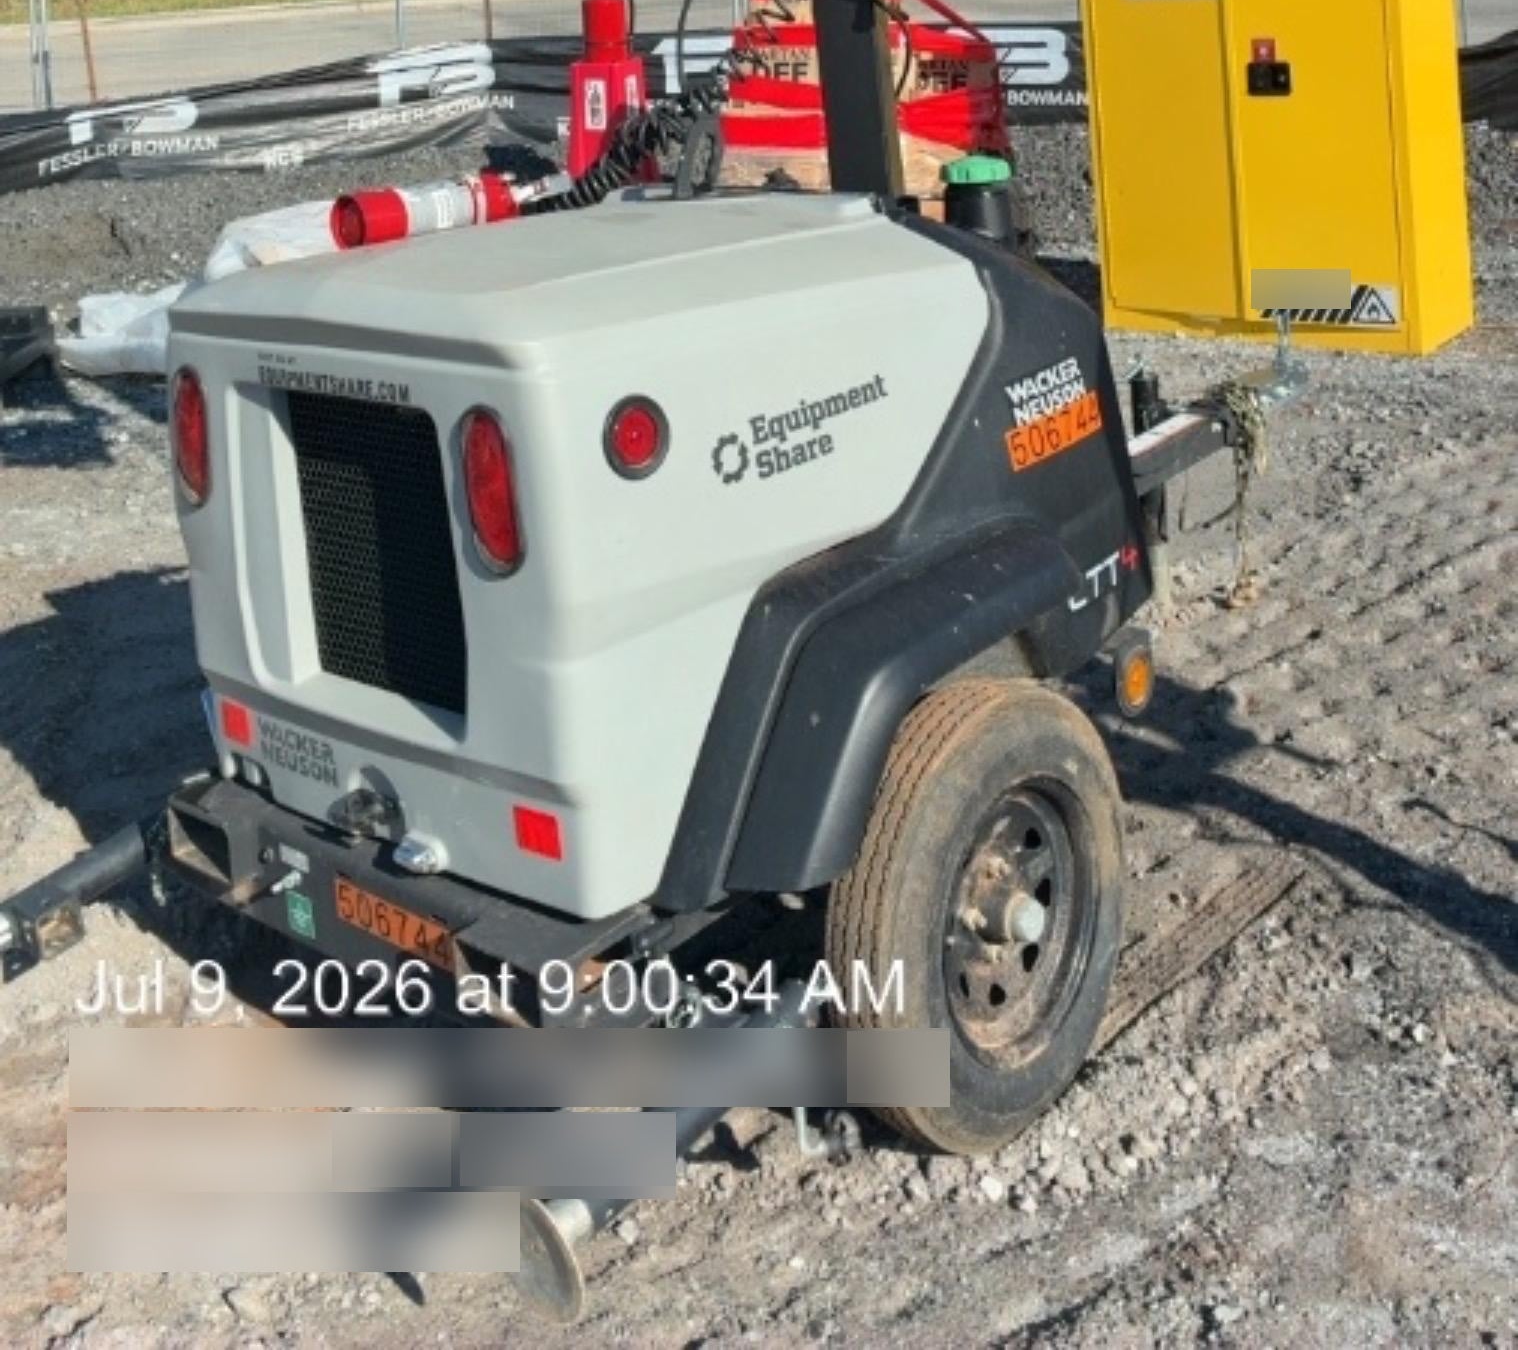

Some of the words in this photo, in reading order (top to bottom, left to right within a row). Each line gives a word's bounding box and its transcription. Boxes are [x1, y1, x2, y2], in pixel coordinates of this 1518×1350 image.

[131, 134, 221, 157] BOWMAN
[1004, 356, 1082, 405] WACKER
[1013, 377, 1088, 428] NEUSON
[748, 373, 888, 445] Equipment
[755, 434, 834, 479] Share
[1009, 405, 1099, 466] 506744
[257, 715, 335, 765] WACKER
[261, 743, 339, 789] NEUSON
[337, 884, 451, 966] 506744
